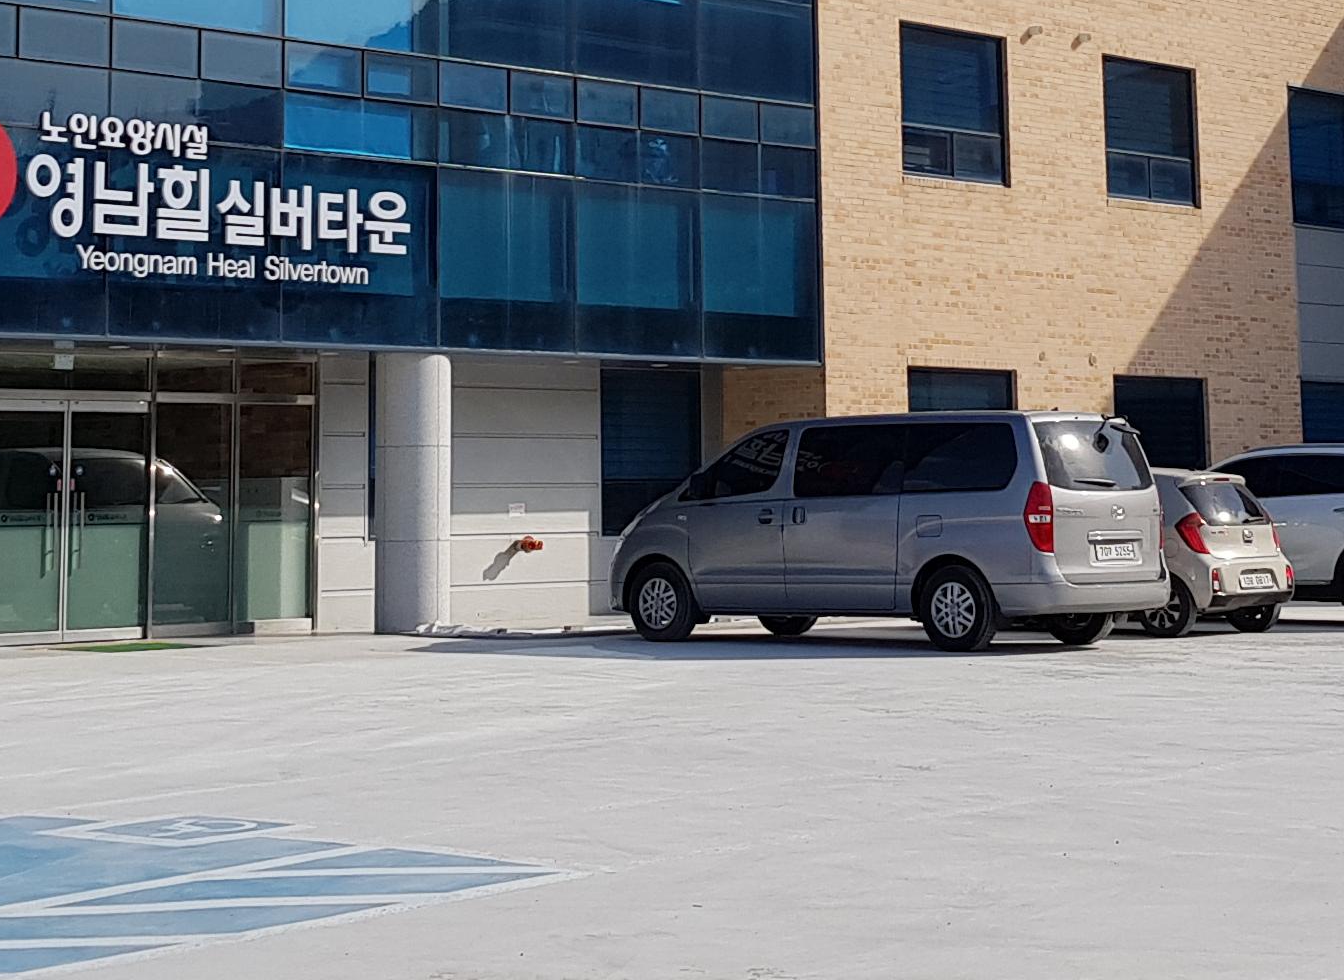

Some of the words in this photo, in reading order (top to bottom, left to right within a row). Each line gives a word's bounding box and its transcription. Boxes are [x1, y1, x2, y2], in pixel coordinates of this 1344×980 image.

[39, 110, 209, 161] 노인요양시설
[76, 243, 198, 279] Yeongnam
[206, 252, 256, 280] Heal
[264, 255, 370, 286] Silvertown
